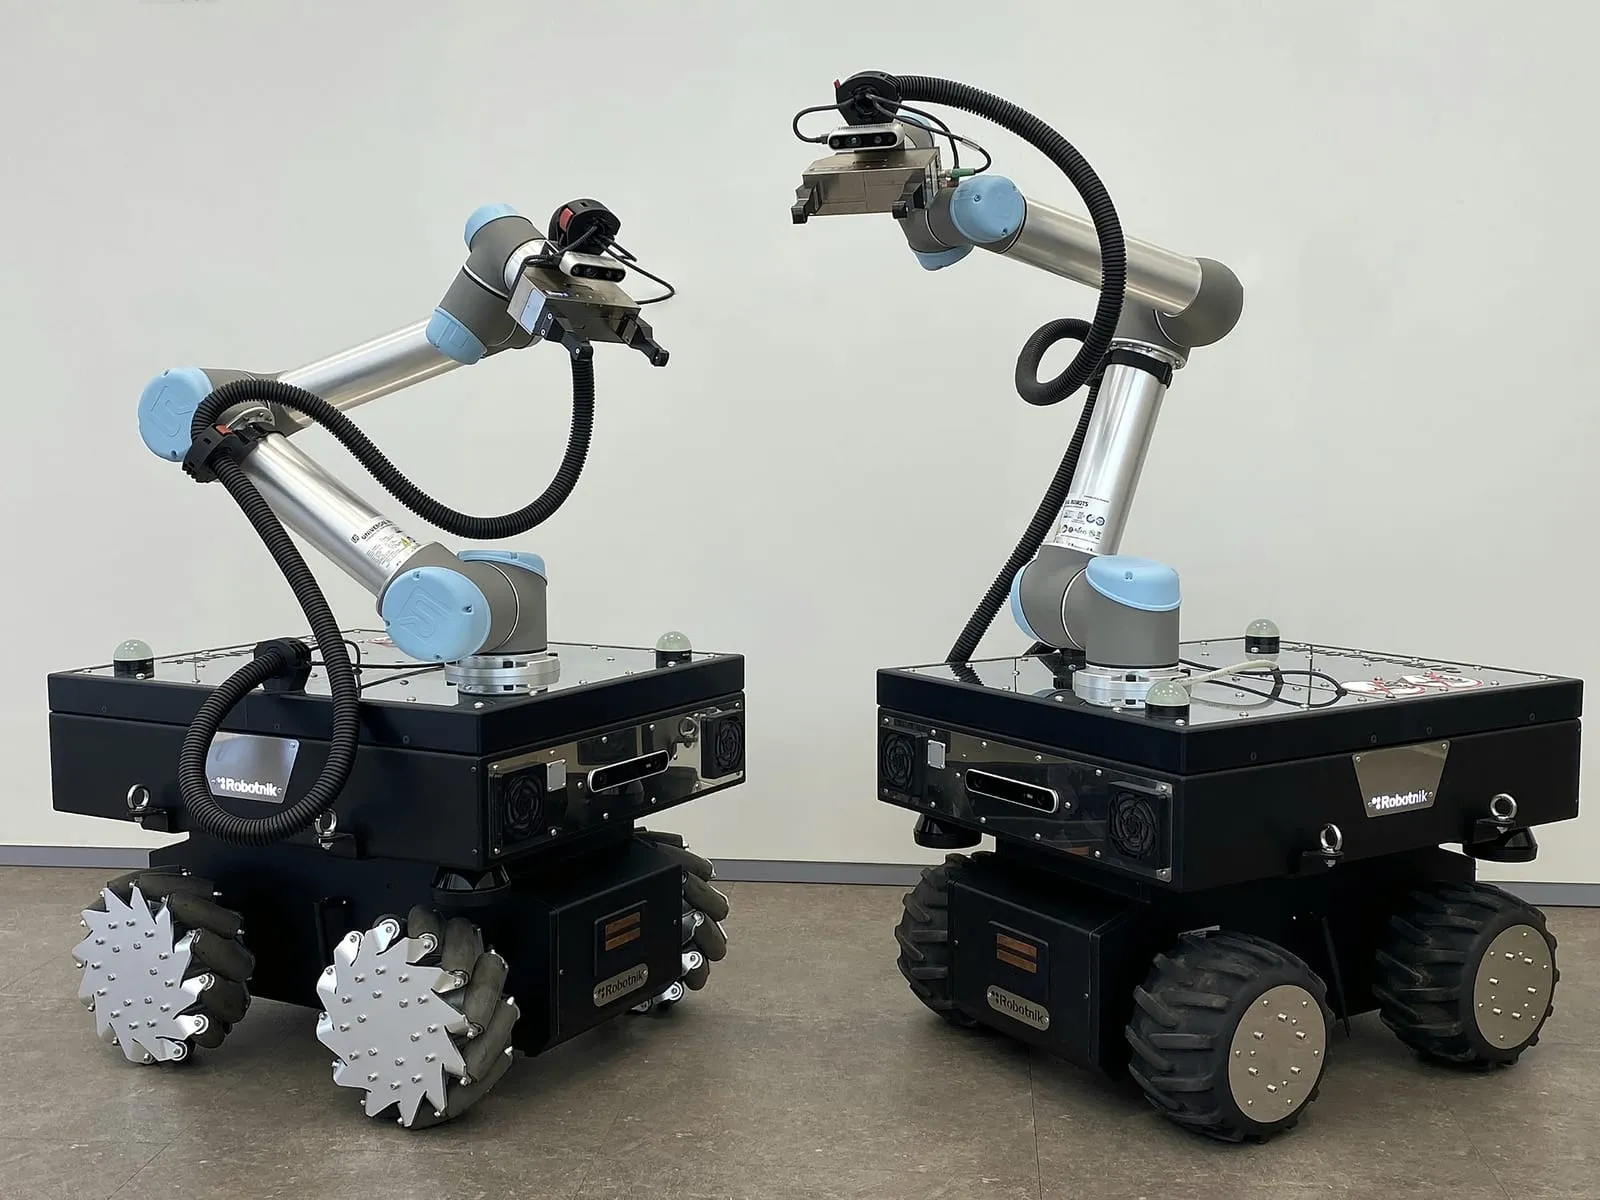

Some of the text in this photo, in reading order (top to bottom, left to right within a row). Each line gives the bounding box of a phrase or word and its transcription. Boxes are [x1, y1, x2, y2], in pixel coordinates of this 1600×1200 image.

[226, 778, 278, 797] Robotnik
[1381, 789, 1429, 810] Robotnik
[605, 970, 645, 997] Robotnik
[1000, 994, 1044, 1024] Robotnik
